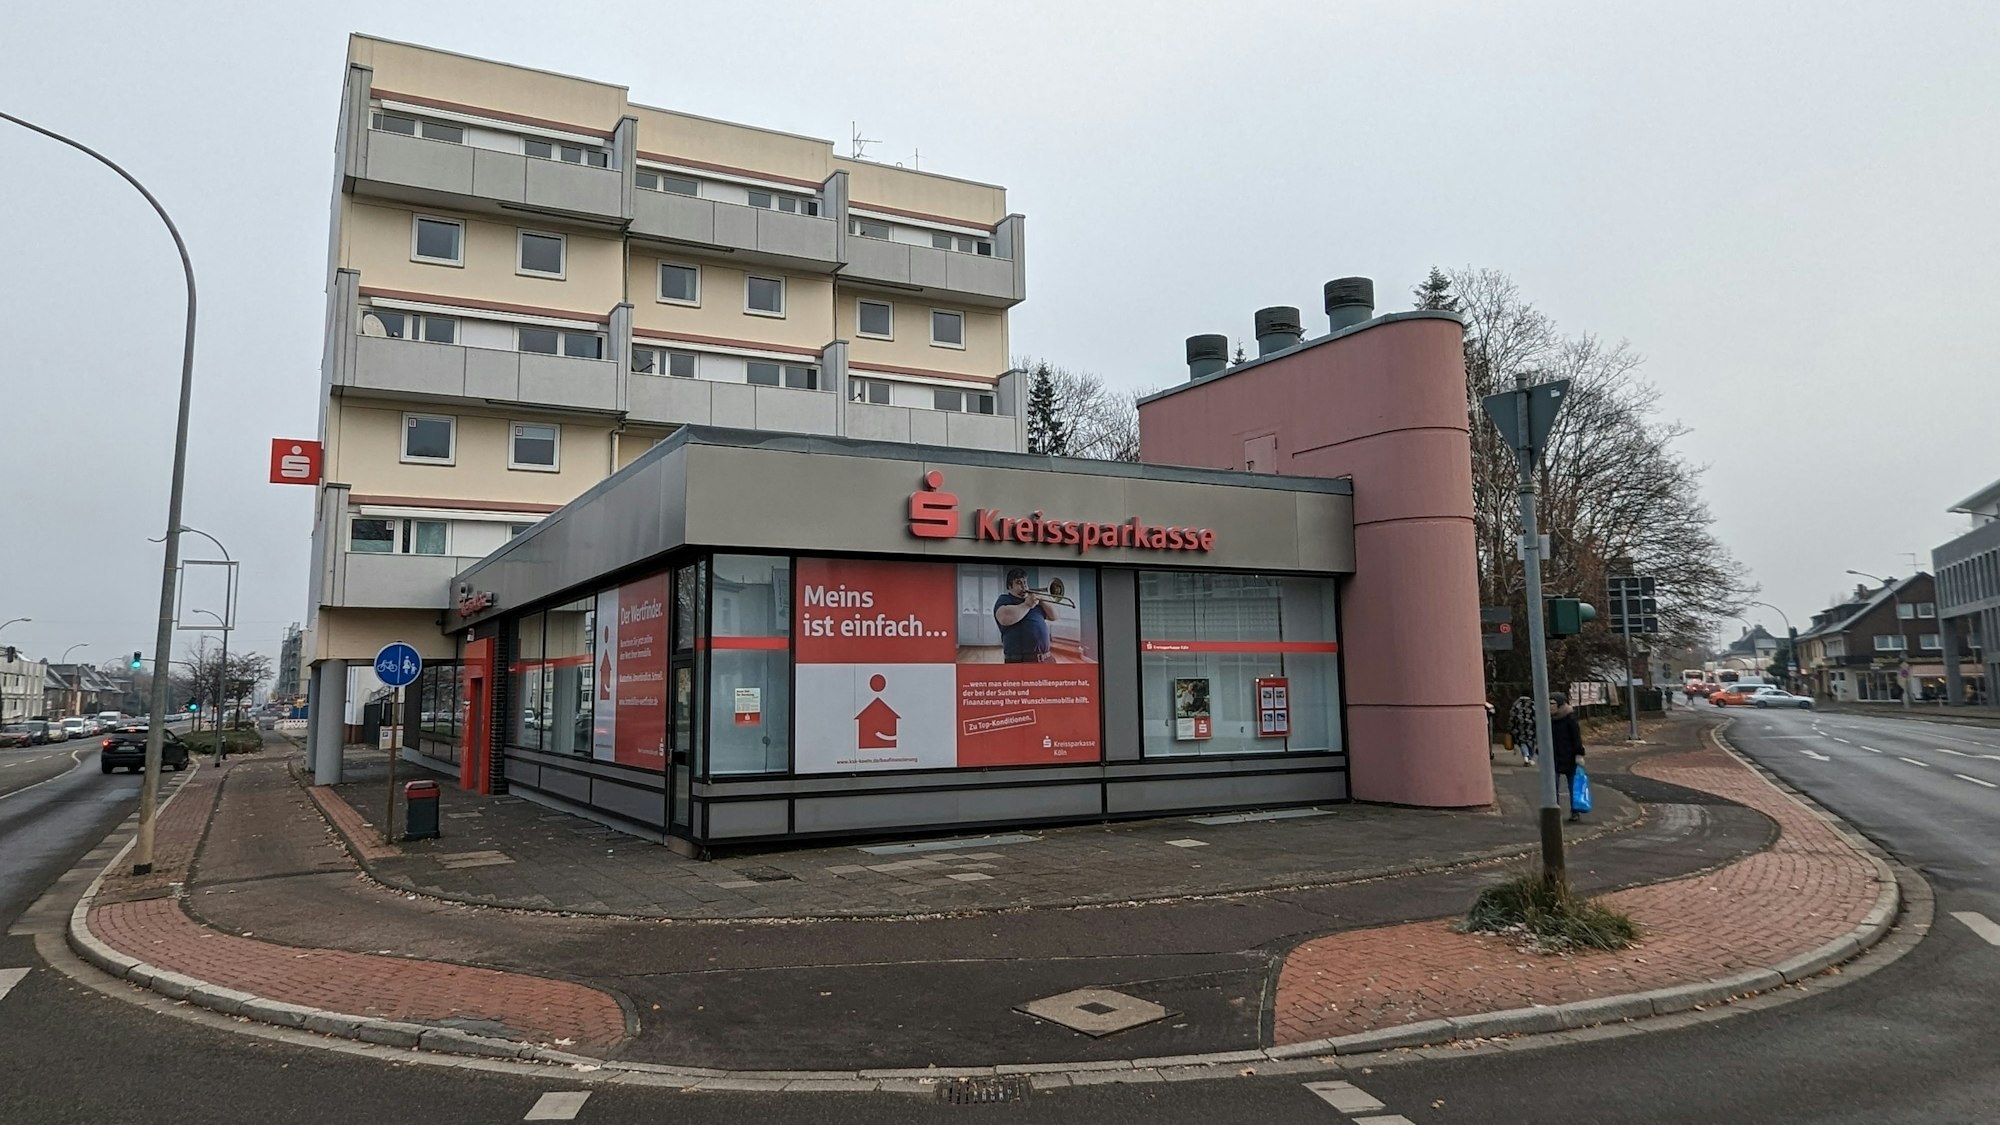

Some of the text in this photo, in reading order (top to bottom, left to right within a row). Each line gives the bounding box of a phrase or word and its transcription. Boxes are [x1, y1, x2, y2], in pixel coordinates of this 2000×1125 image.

[975, 507, 1216, 554] Kreissparkasse
[803, 584, 874, 609] Meins
[620, 598, 663, 625] Der Wertfinder.
[803, 613, 948, 638] ist einfach...
[1022, 680, 1077, 688] Immobilienpartner
[962, 698, 1004, 706] Finanzierung
[1021, 697, 1074, 705] Wunschimmobilie
[968, 715, 1032, 731] Zu Top-Konditionen.
[1054, 740, 1096, 748] Kreissparkasse
